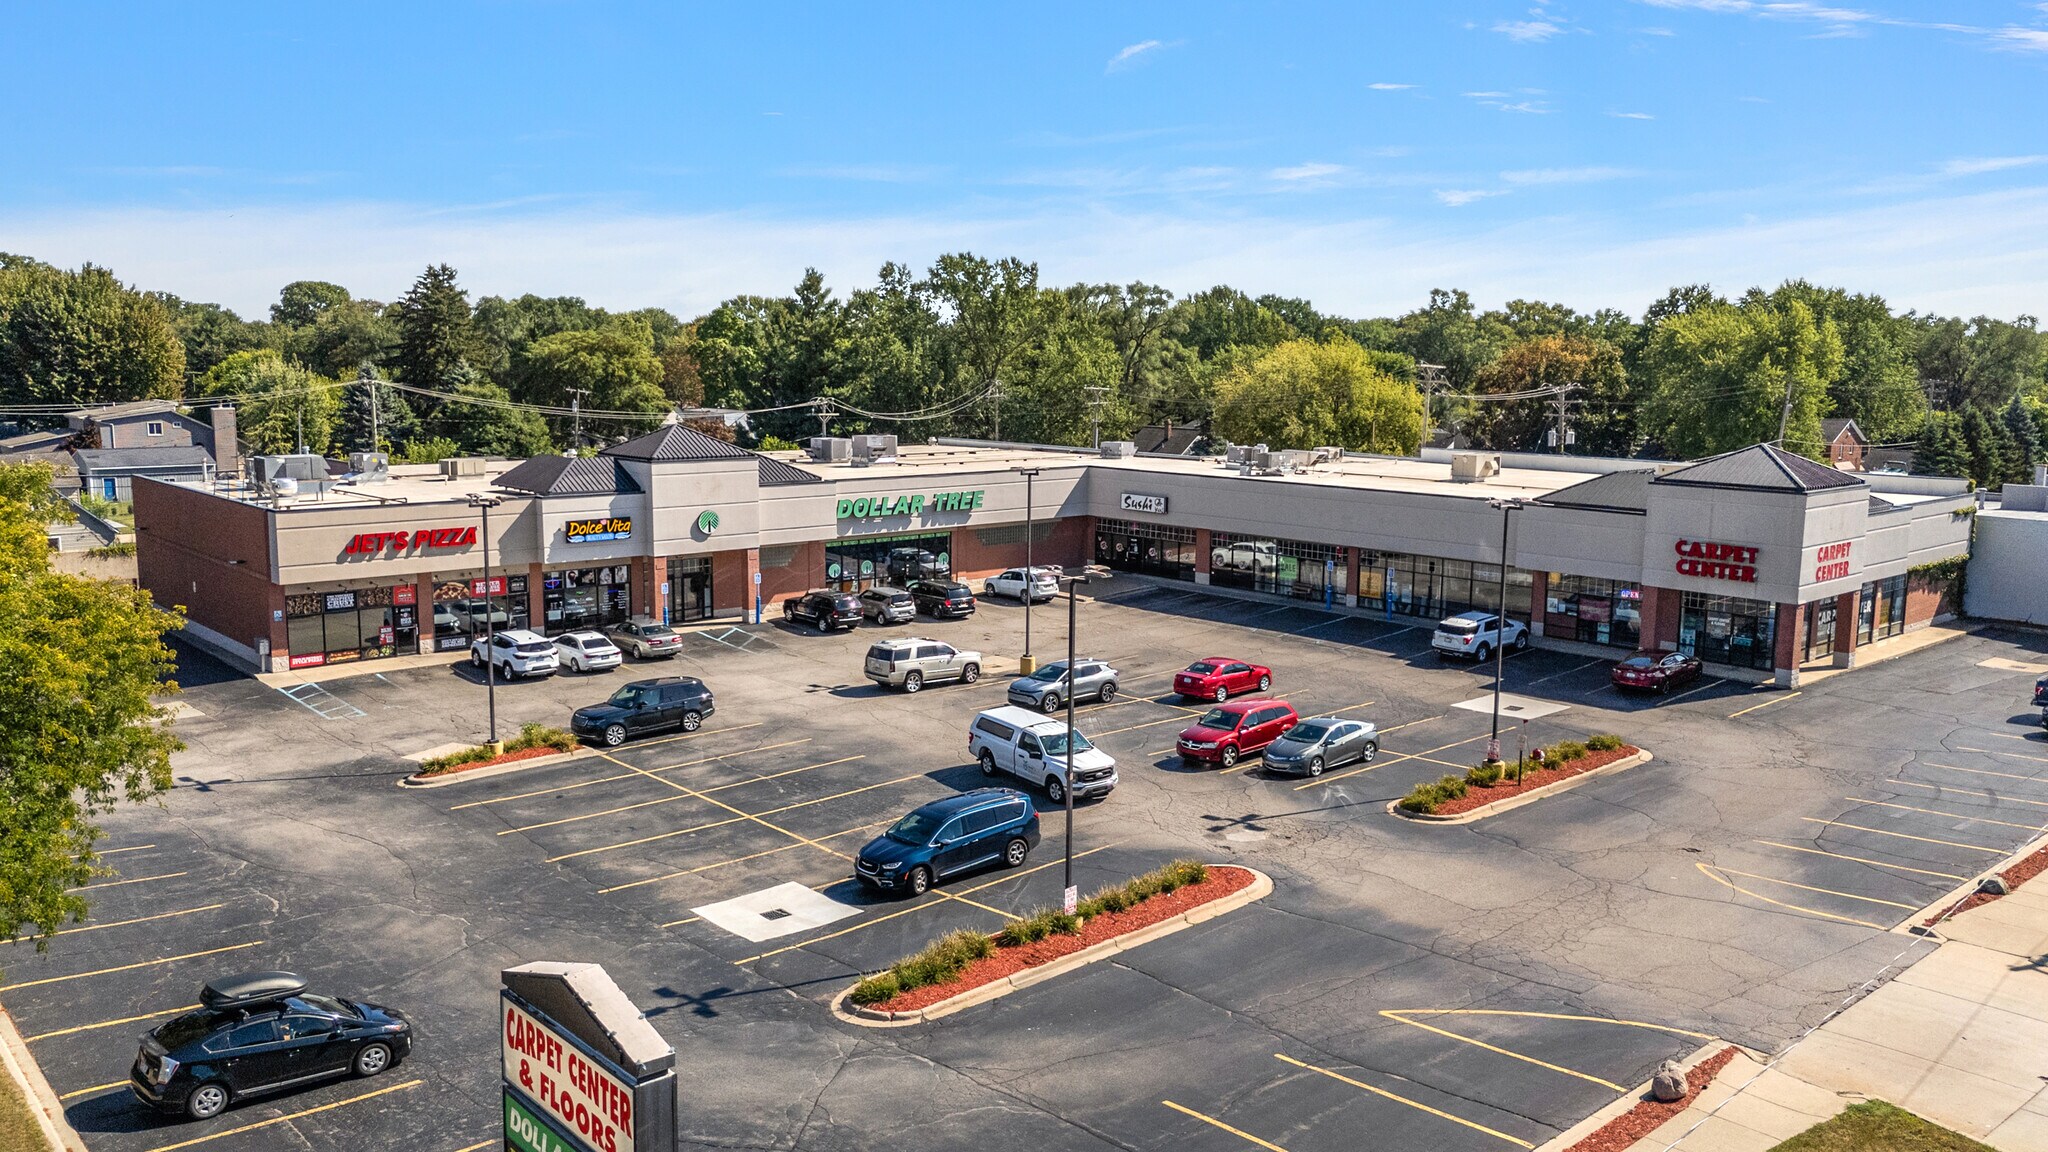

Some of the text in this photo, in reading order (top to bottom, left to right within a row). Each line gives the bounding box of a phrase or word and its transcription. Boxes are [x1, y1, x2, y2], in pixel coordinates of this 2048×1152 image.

[837, 490, 984, 518] DOLLAR TREE
[1124, 495, 1153, 510] Sushi
[568, 519, 631, 535] Dolce Vita
[345, 526, 478, 554] JET'S PIZZA
[1675, 539, 1759, 564] CARPET
[1817, 542, 1852, 563] CARPET
[1675, 559, 1757, 583] CENTER
[1815, 560, 1850, 582] CENTER
[1621, 590, 1639, 599] OPEN
[506, 1008, 632, 1140] CARPET CENTER
[519, 1058, 617, 1152] & FLOORS
